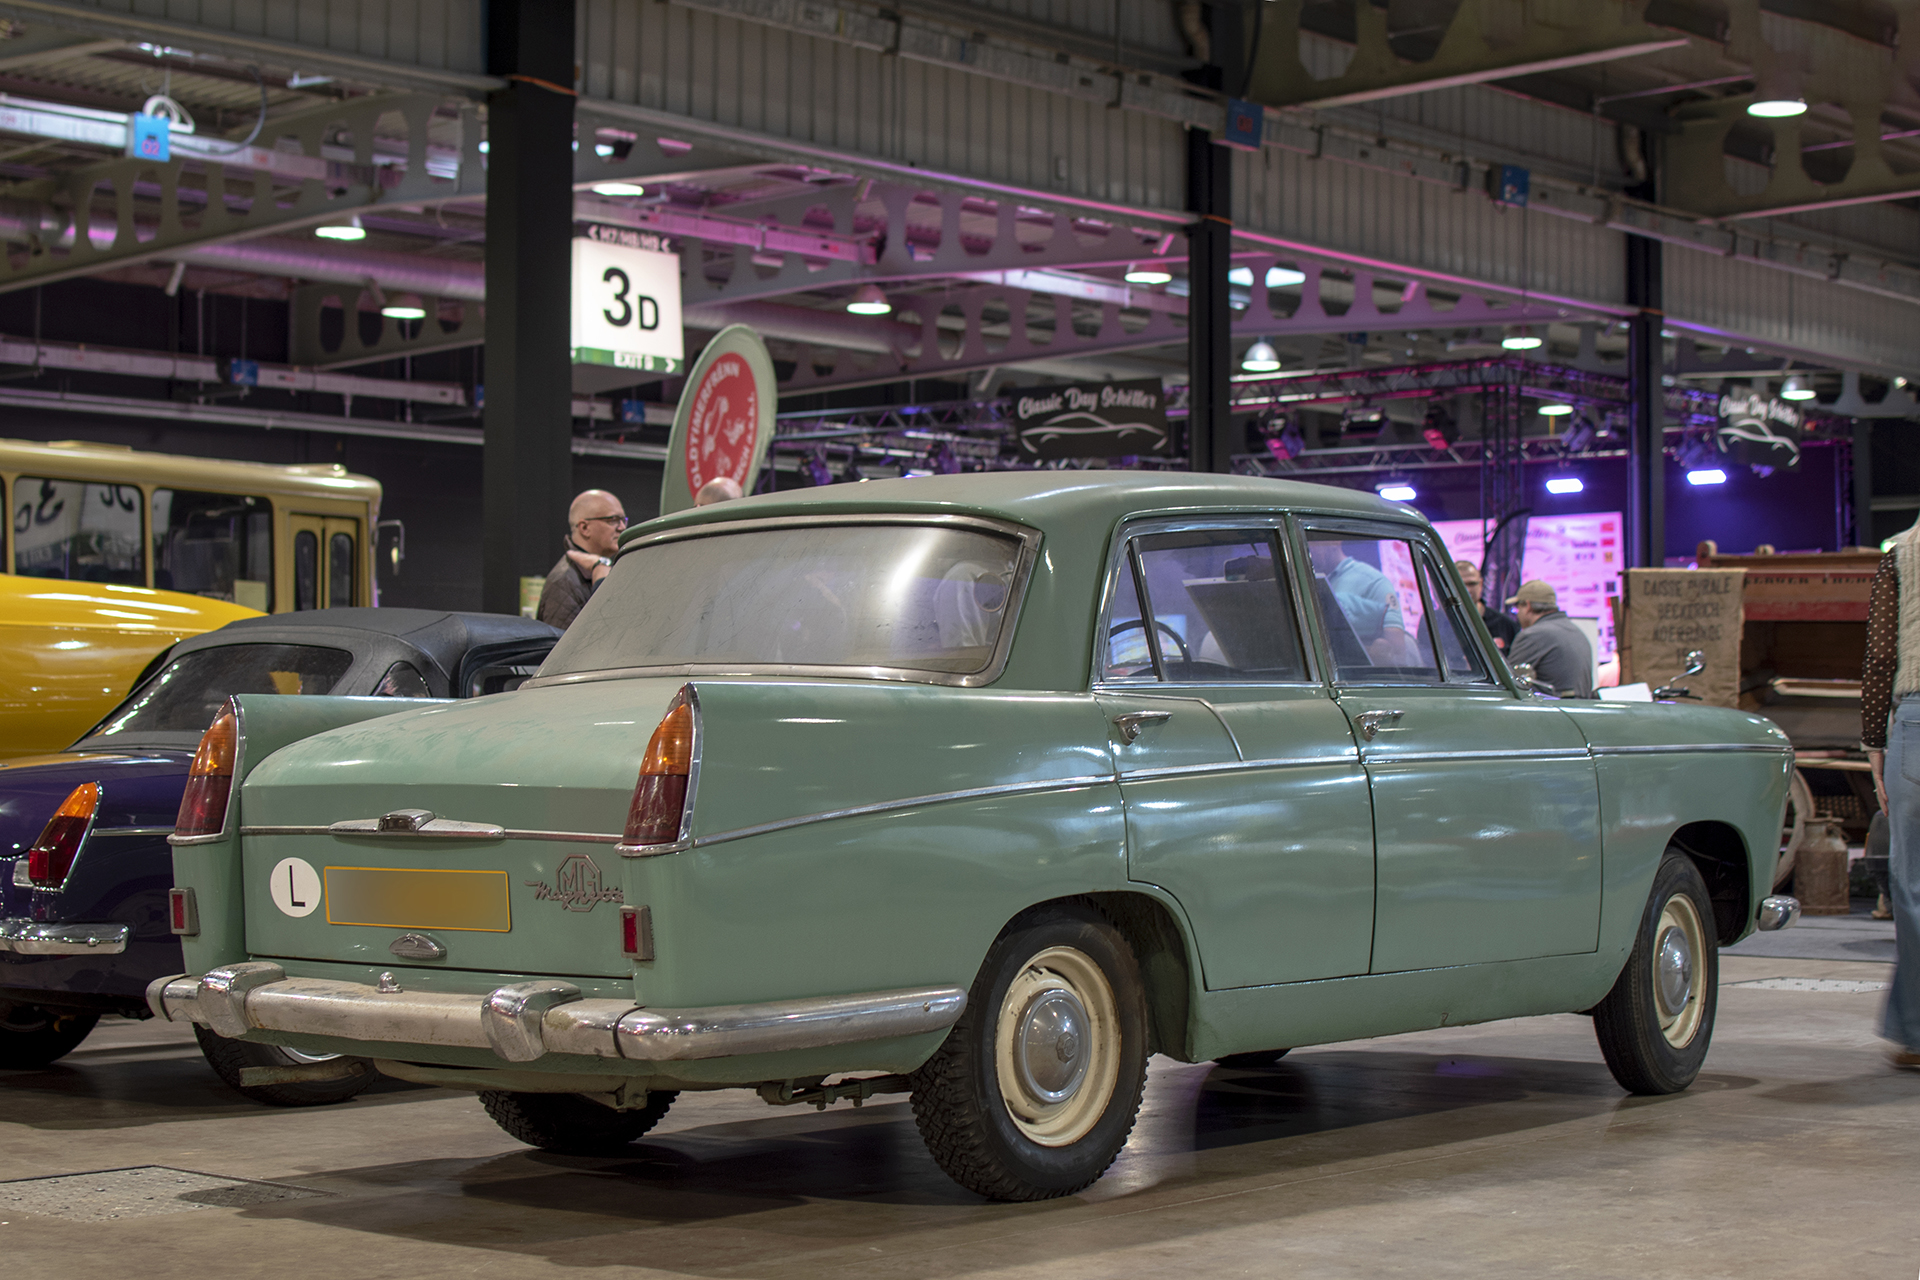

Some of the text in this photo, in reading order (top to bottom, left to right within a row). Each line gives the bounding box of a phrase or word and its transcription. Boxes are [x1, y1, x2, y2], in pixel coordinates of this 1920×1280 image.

[614, 351, 642, 369] EXIT
[1018, 393, 1063, 420] Classic
[1064, 387, 1098, 412] Day
[289, 865, 306, 907] L
